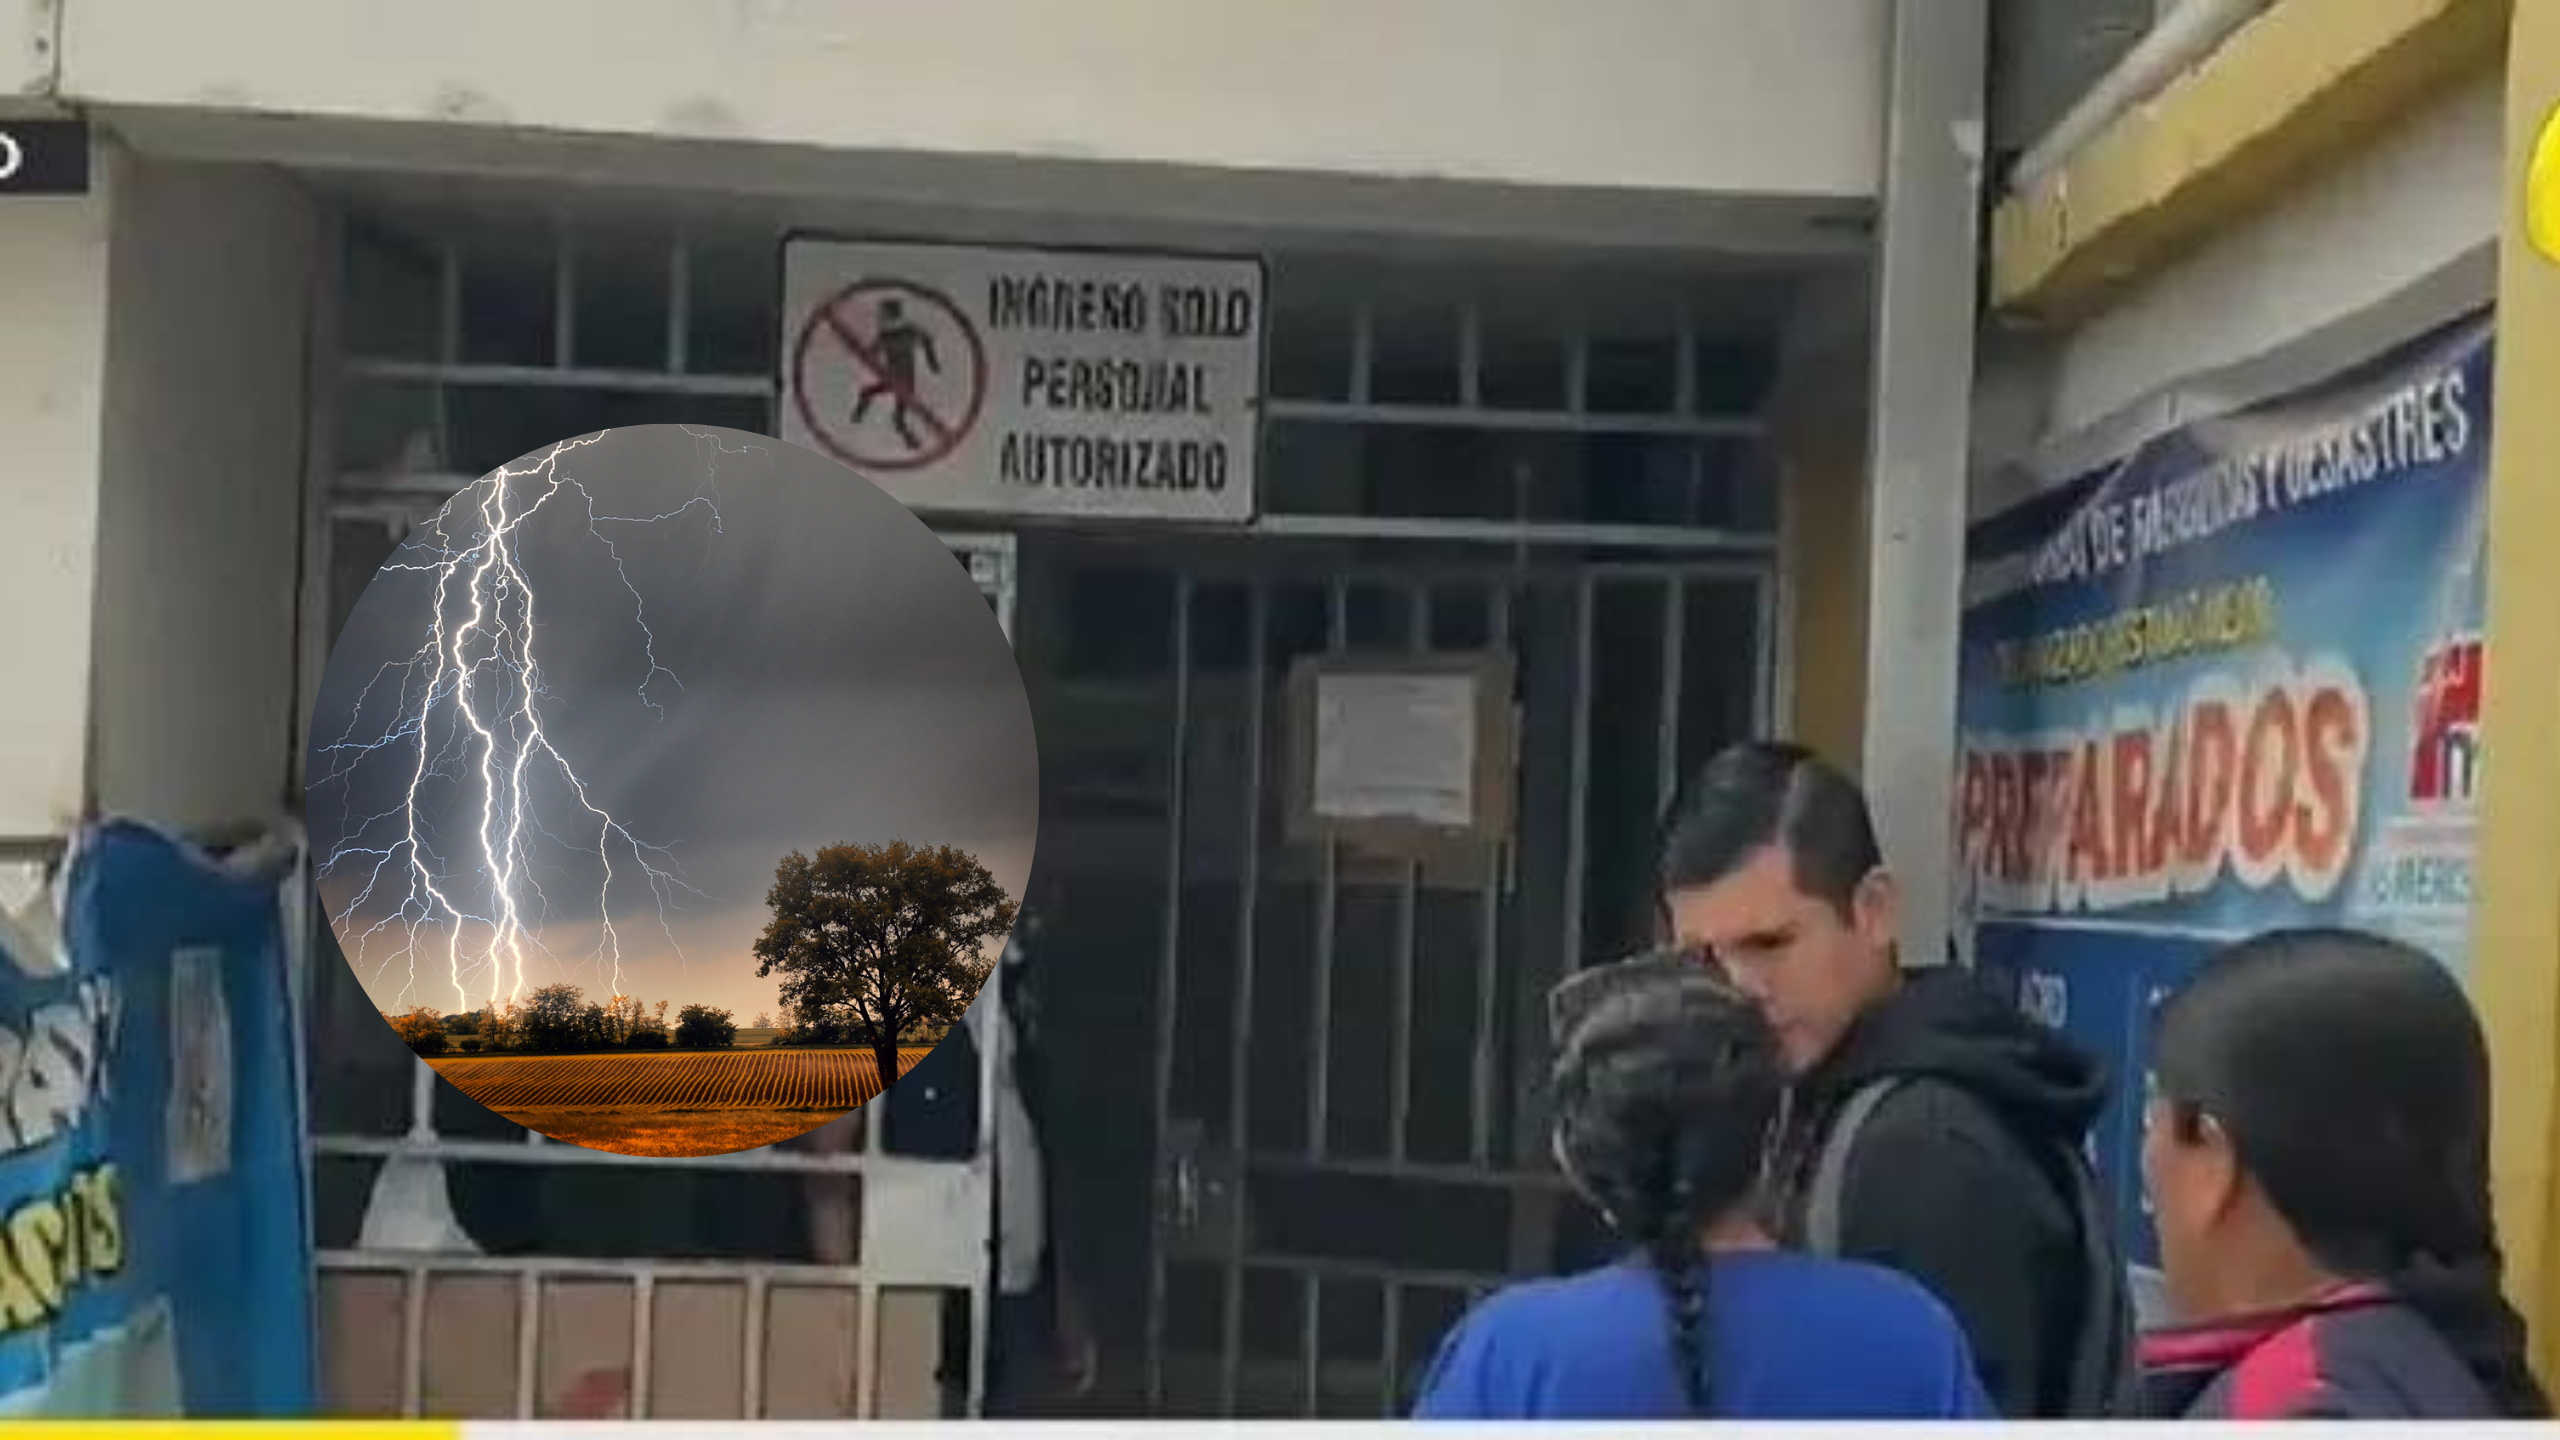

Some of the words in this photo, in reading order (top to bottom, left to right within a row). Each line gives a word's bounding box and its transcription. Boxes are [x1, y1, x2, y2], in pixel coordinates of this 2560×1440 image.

[989, 271, 1148, 335] INGRESO
[1160, 284, 1253, 339] SOLO
[1001, 431, 1228, 494] AUTORIZADO
